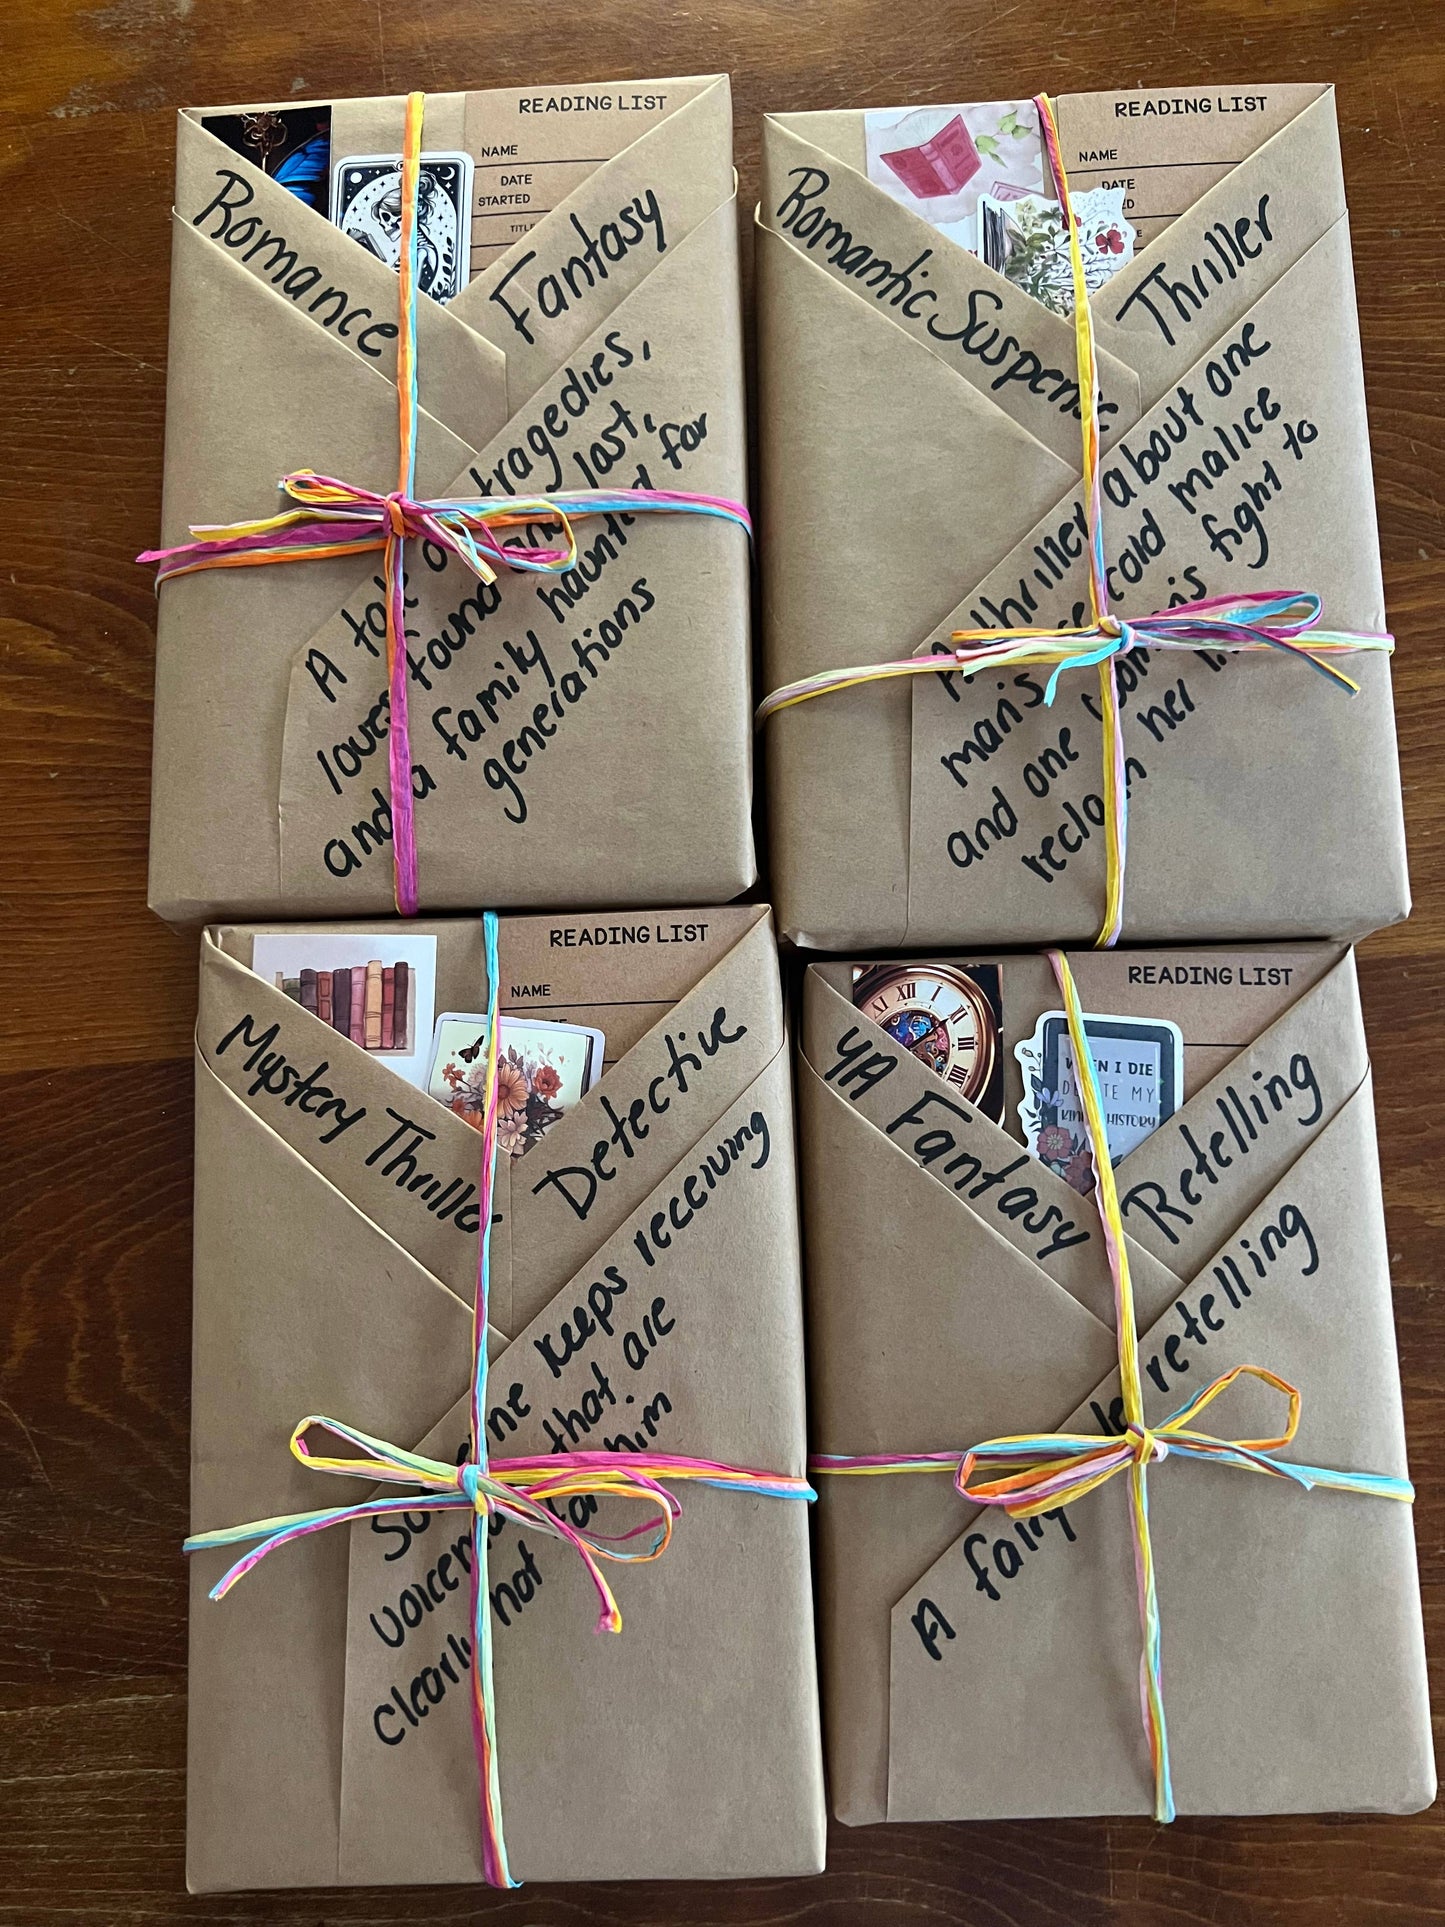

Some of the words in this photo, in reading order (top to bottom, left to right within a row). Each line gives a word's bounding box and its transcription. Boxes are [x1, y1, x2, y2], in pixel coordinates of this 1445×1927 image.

[481, 145, 518, 157] NAME
[519, 97, 612, 114] READING
[618, 95, 667, 111] LIST
[1079, 149, 1118, 163] NAME
[1115, 100, 1212, 118] READING
[1218, 96, 1268, 113] LIST
[478, 193, 531, 207] STARTED
[500, 174, 533, 186] DATE
[1102, 179, 1136, 190] DATE
[193, 169, 399, 357] Romance
[489, 189, 667, 344] Fantasy
[777, 167, 936, 318] Romantic
[1116, 194, 1274, 346] Thriller
[1102, 386, 1204, 507] about
[1205, 322, 1270, 397] one
[1105, 508, 1165, 601] cold
[1169, 386, 1281, 514] malice
[305, 648, 347, 703] A
[947, 786, 1018, 868] and
[1023, 727, 1079, 797] one
[1201, 461, 1283, 568] fight
[1283, 420, 1319, 460] to
[411, 764, 437, 799] a
[432, 629, 556, 760] family
[483, 576, 656, 824] generations
[1136, 678, 1196, 742] her
[550, 926, 650, 947] READING
[656, 924, 709, 943] LIST
[1128, 966, 1233, 985] READING
[1239, 966, 1293, 987] LIST
[511, 984, 551, 998] NAME
[216, 1014, 366, 1144] Mystery
[532, 1006, 748, 1219] Detective
[1106, 1113, 1156, 1128] HISTORY
[1115, 1061, 1121, 1074] I
[1128, 1062, 1153, 1076] DIE
[1131, 1086, 1155, 1103] MY
[634, 1111, 771, 1267] receiving
[824, 1026, 898, 1100] YA
[886, 1090, 1091, 1259] Fantasy
[1122, 1052, 1324, 1244] Retelling
[542, 1361, 616, 1453] that
[623, 1296, 676, 1370] are
[911, 1598, 957, 1661] A
[1146, 1203, 1319, 1393] retelling
[488, 1540, 543, 1626] not
